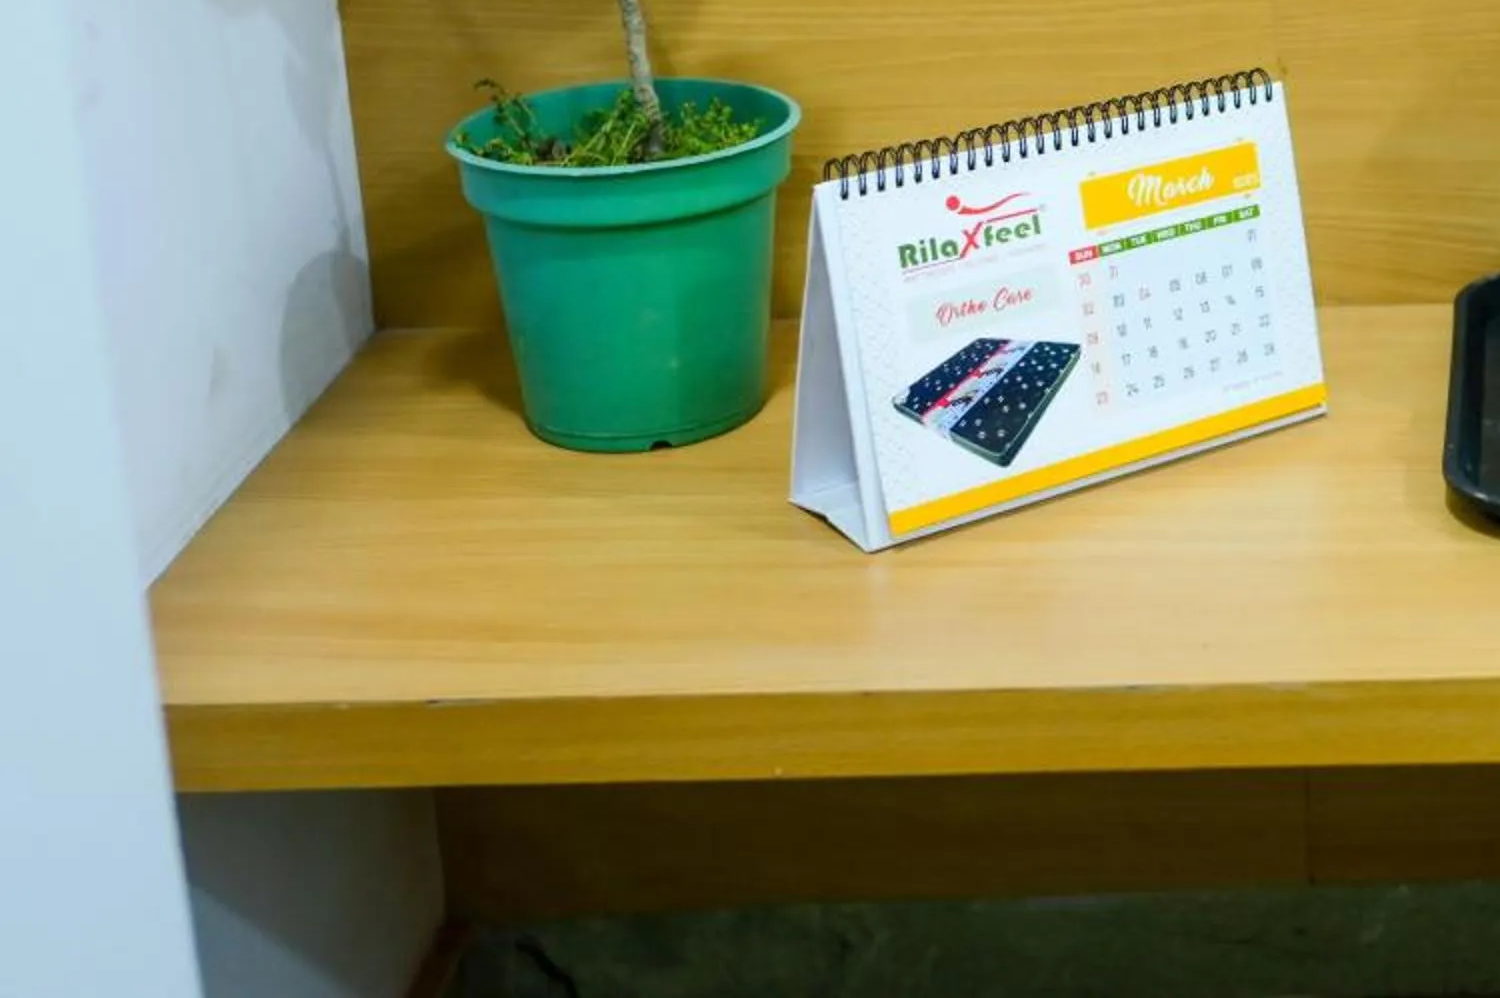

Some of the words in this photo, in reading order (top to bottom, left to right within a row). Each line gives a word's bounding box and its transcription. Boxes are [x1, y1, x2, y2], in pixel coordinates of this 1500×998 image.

[1126, 166, 1215, 208] March
[897, 213, 1042, 270] RilaXfeel
[993, 286, 1033, 312] Care
